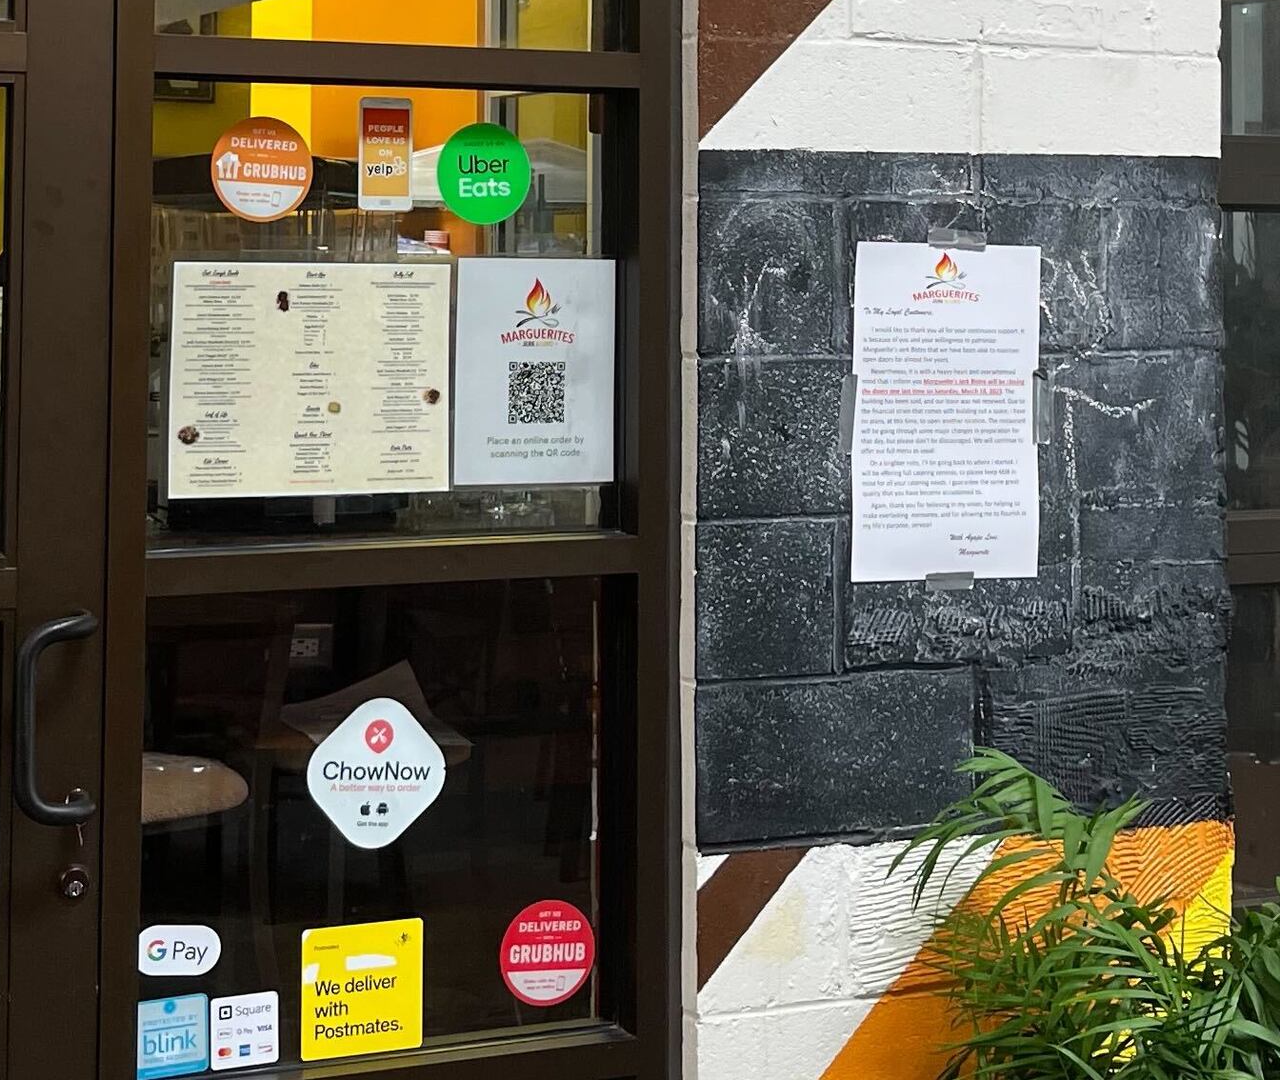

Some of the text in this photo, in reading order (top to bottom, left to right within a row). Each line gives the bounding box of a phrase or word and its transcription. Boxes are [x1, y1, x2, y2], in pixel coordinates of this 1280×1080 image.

[368, 125, 404, 133] PEOPLE
[231, 136, 298, 152] DELIVERED
[366, 136, 406, 145] LOVE US
[243, 162, 307, 181] GRUBHUB
[366, 162, 394, 177] yelp
[458, 154, 510, 174] Uber
[458, 178, 511, 198] Eats
[913, 289, 980, 303] MARGUERITES
[500, 328, 575, 345] MARGUERITES
[487, 436, 584, 446] Place an online order by
[490, 449, 529, 459] scanning
[530, 448, 544, 457] the
[545, 448, 559, 458] QR
[322, 760, 431, 781] ChowNow
[329, 783, 421, 794] A better way to order
[518, 920, 582, 933] DELIVERED
[146, 939, 209, 966] G Pay
[509, 942, 586, 964] GRUBHUB
[314, 974, 397, 997] We deliver
[235, 1003, 272, 1018] Square
[314, 1000, 349, 1018] with
[257, 1024, 273, 1033] VISA
[314, 1019, 403, 1040] Postmates.
[143, 1029, 197, 1056] blink
